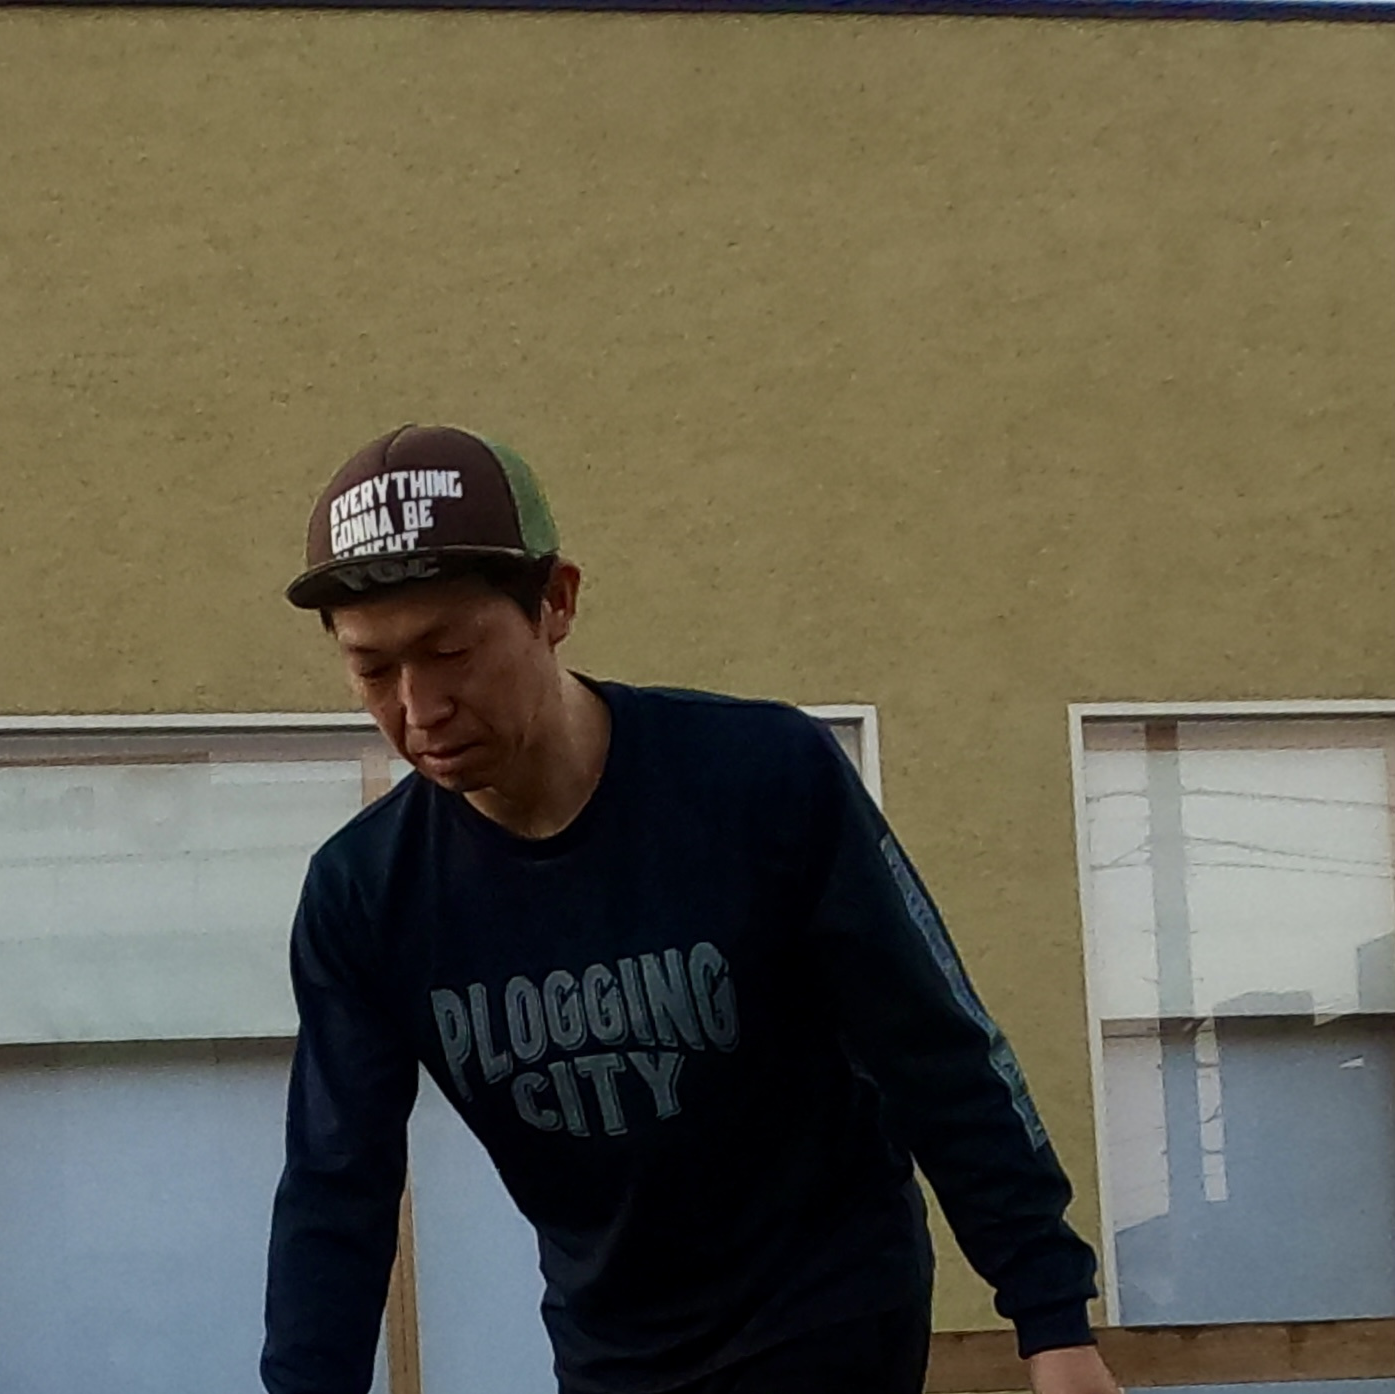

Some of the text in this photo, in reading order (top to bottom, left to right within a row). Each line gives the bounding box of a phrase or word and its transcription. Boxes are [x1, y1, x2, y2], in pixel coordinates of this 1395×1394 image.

[330, 469, 463, 525] EVERYTHING
[331, 498, 434, 555] GONNA BE
[430, 941, 741, 1103] PLOGGING
[509, 1050, 687, 1138] CITY
